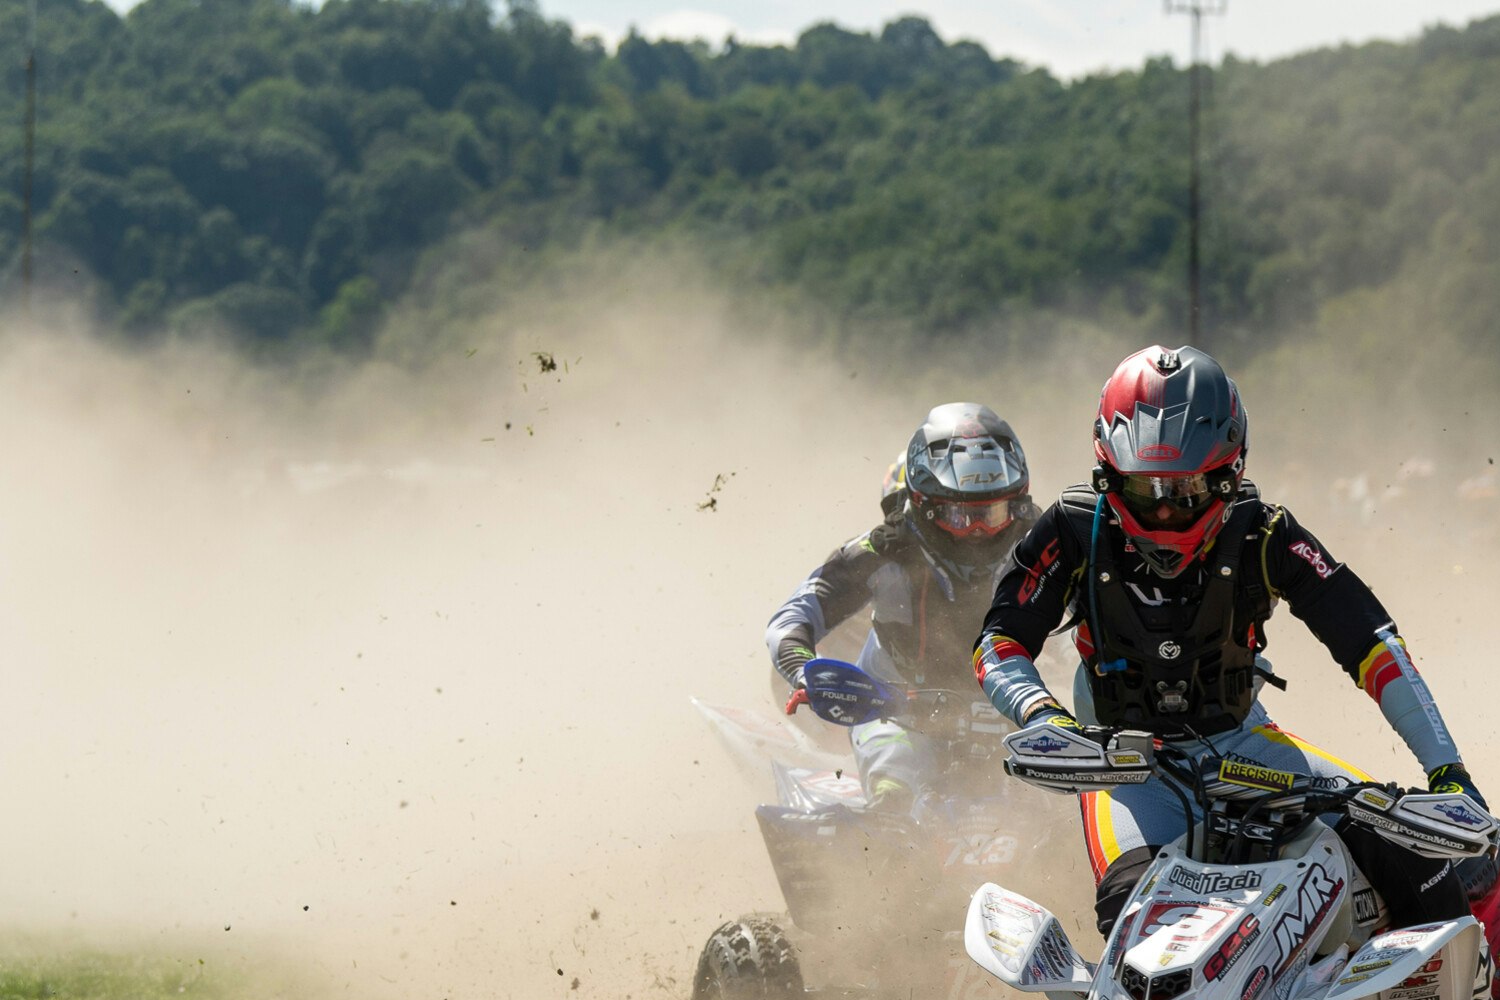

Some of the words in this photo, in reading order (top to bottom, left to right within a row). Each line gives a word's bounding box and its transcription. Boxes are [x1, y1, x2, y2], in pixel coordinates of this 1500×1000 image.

[1142, 449, 1174, 458] BELL
[959, 472, 1003, 486] FLY
[1271, 862, 1338, 982] JMR
[1354, 890, 1376, 923] CTION
[1202, 913, 1261, 983] GBC
